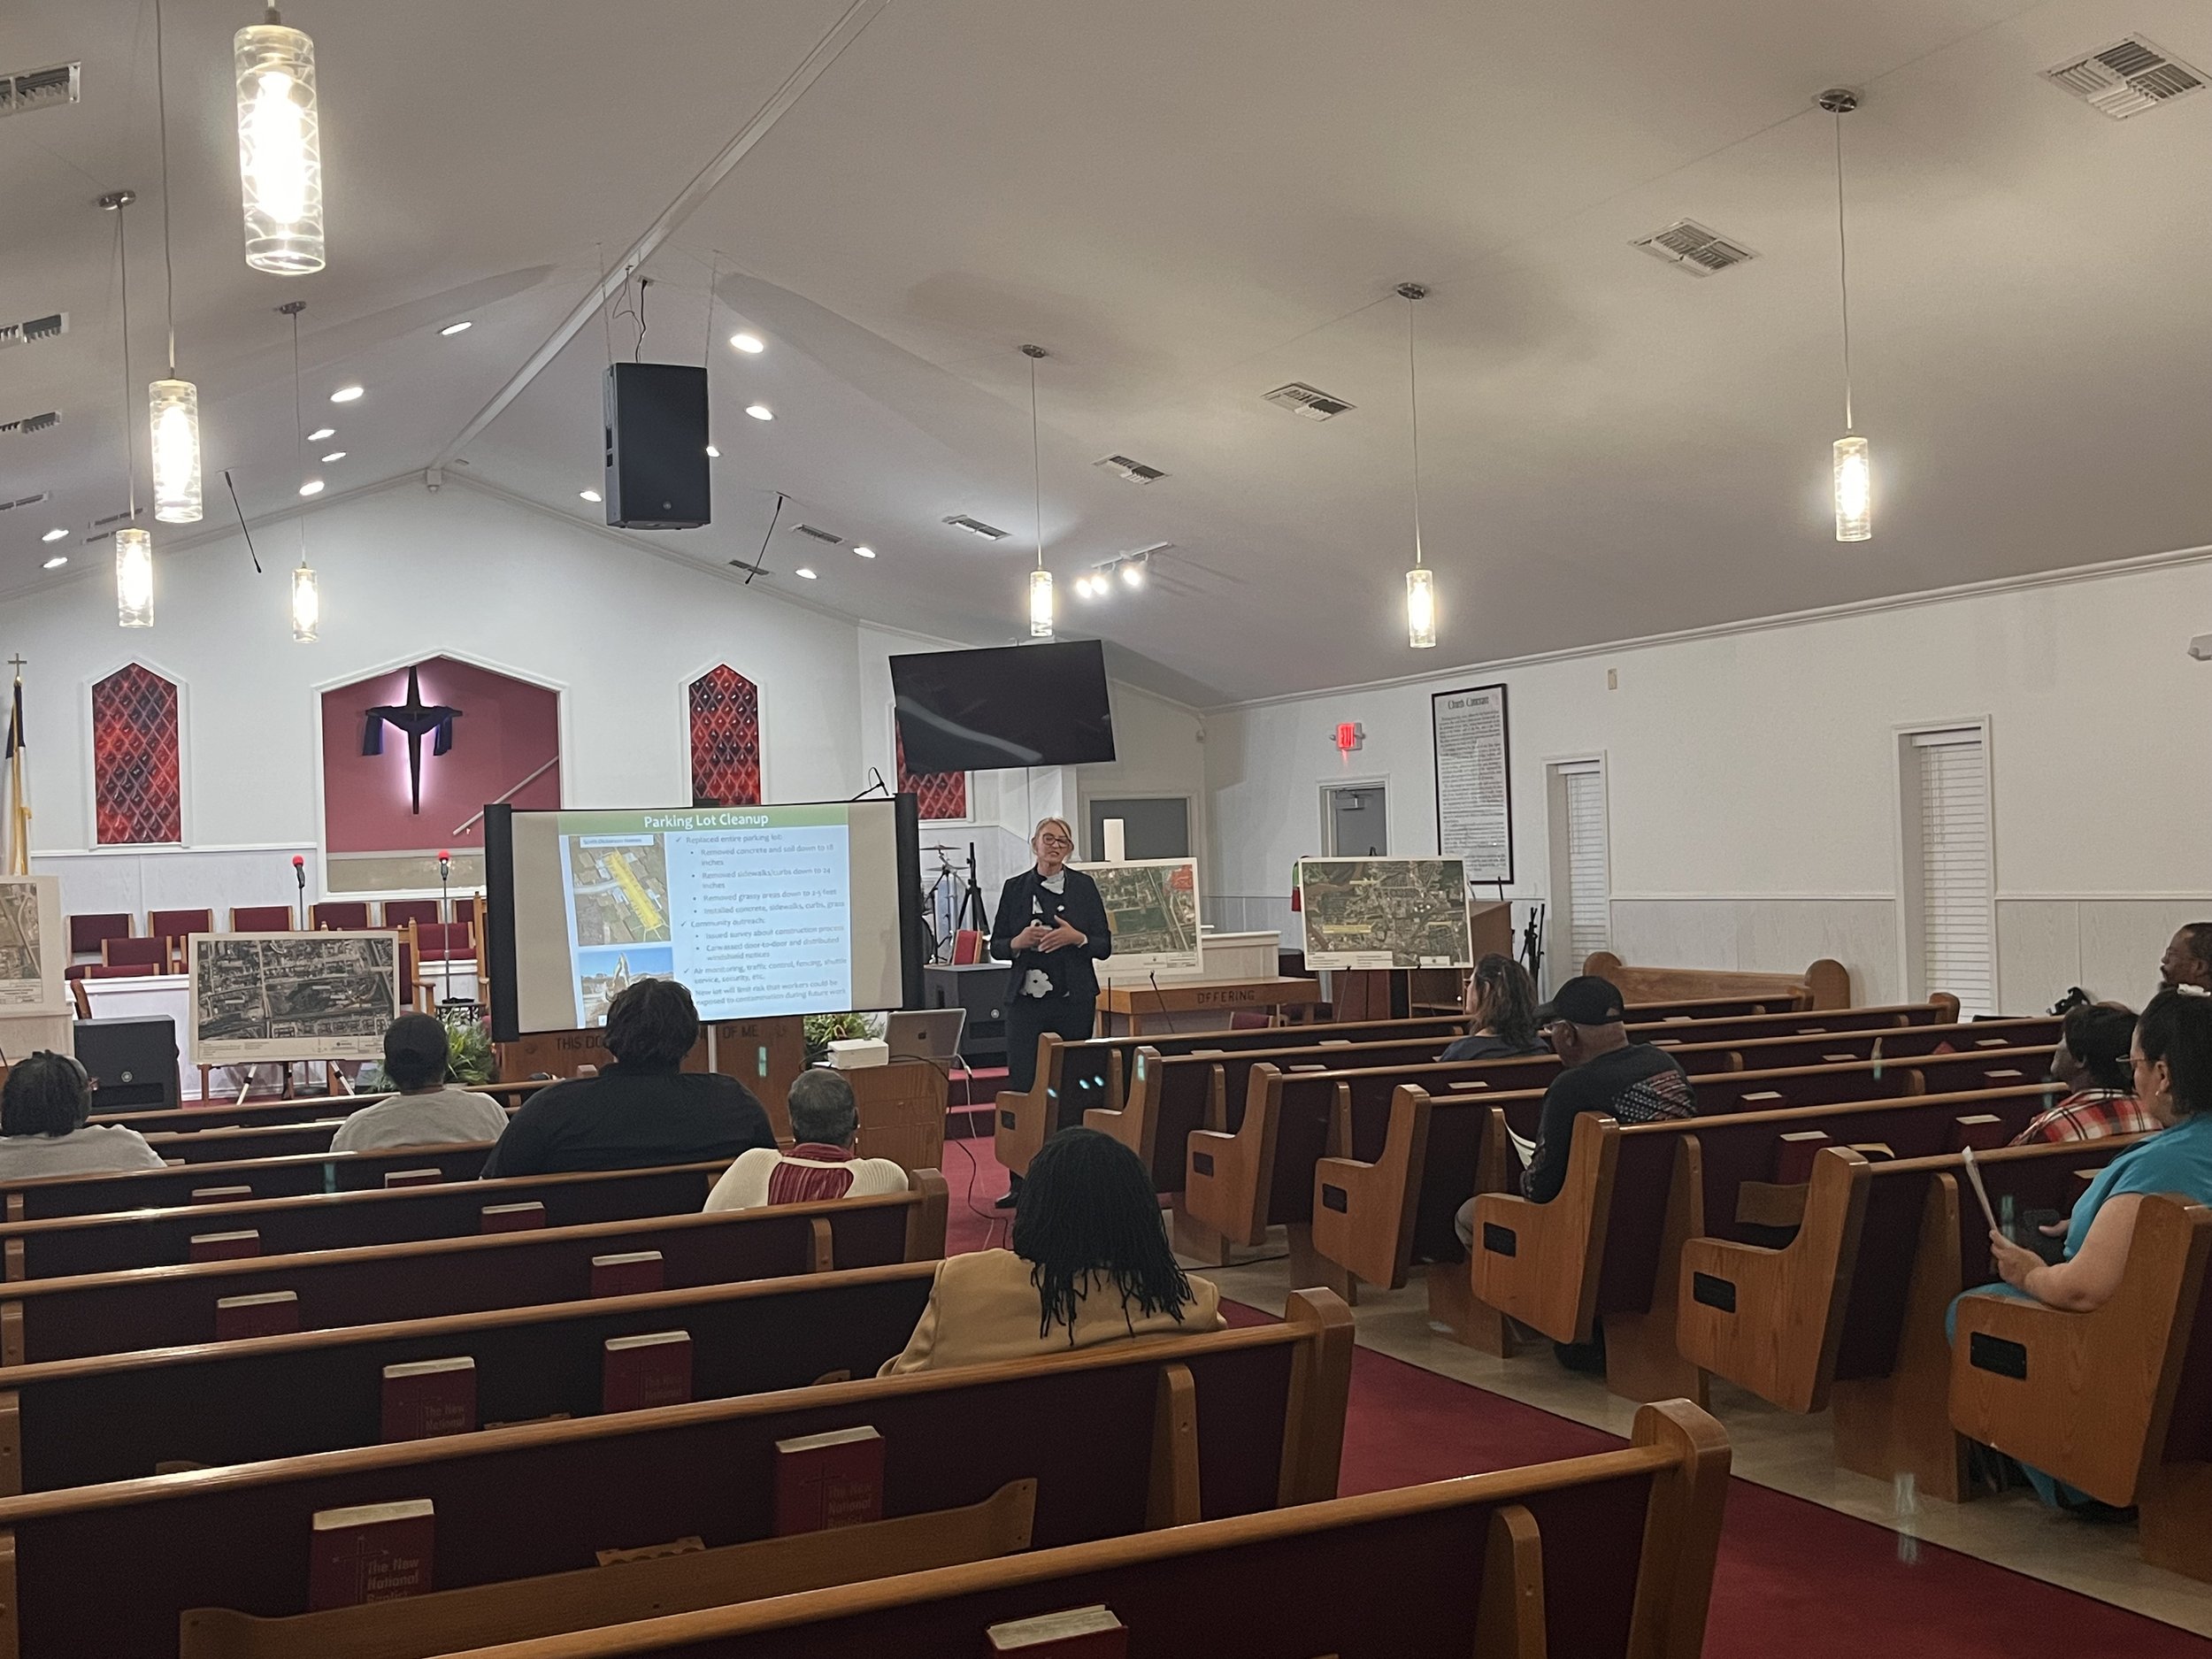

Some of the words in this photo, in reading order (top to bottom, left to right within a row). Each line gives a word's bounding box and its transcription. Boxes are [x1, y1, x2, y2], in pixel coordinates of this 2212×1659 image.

[644, 816, 694, 830] Parking
[696, 814, 717, 826] Lot
[719, 814, 769, 828] Cleanup
[686, 836, 719, 845] Replaced
[743, 833, 769, 842] parking
[703, 871, 736, 879] Removed
[738, 894, 761, 902] grassy
[786, 991, 807, 1000] during
[1197, 990, 1255, 1004] OFFERING
[722, 1026, 739, 1040] OF
[741, 1025, 759, 1039] ME
[557, 1037, 580, 1051] THIS
[368, 1559, 389, 1575] The
[393, 1557, 419, 1571] New
[368, 1570, 419, 1591] National
